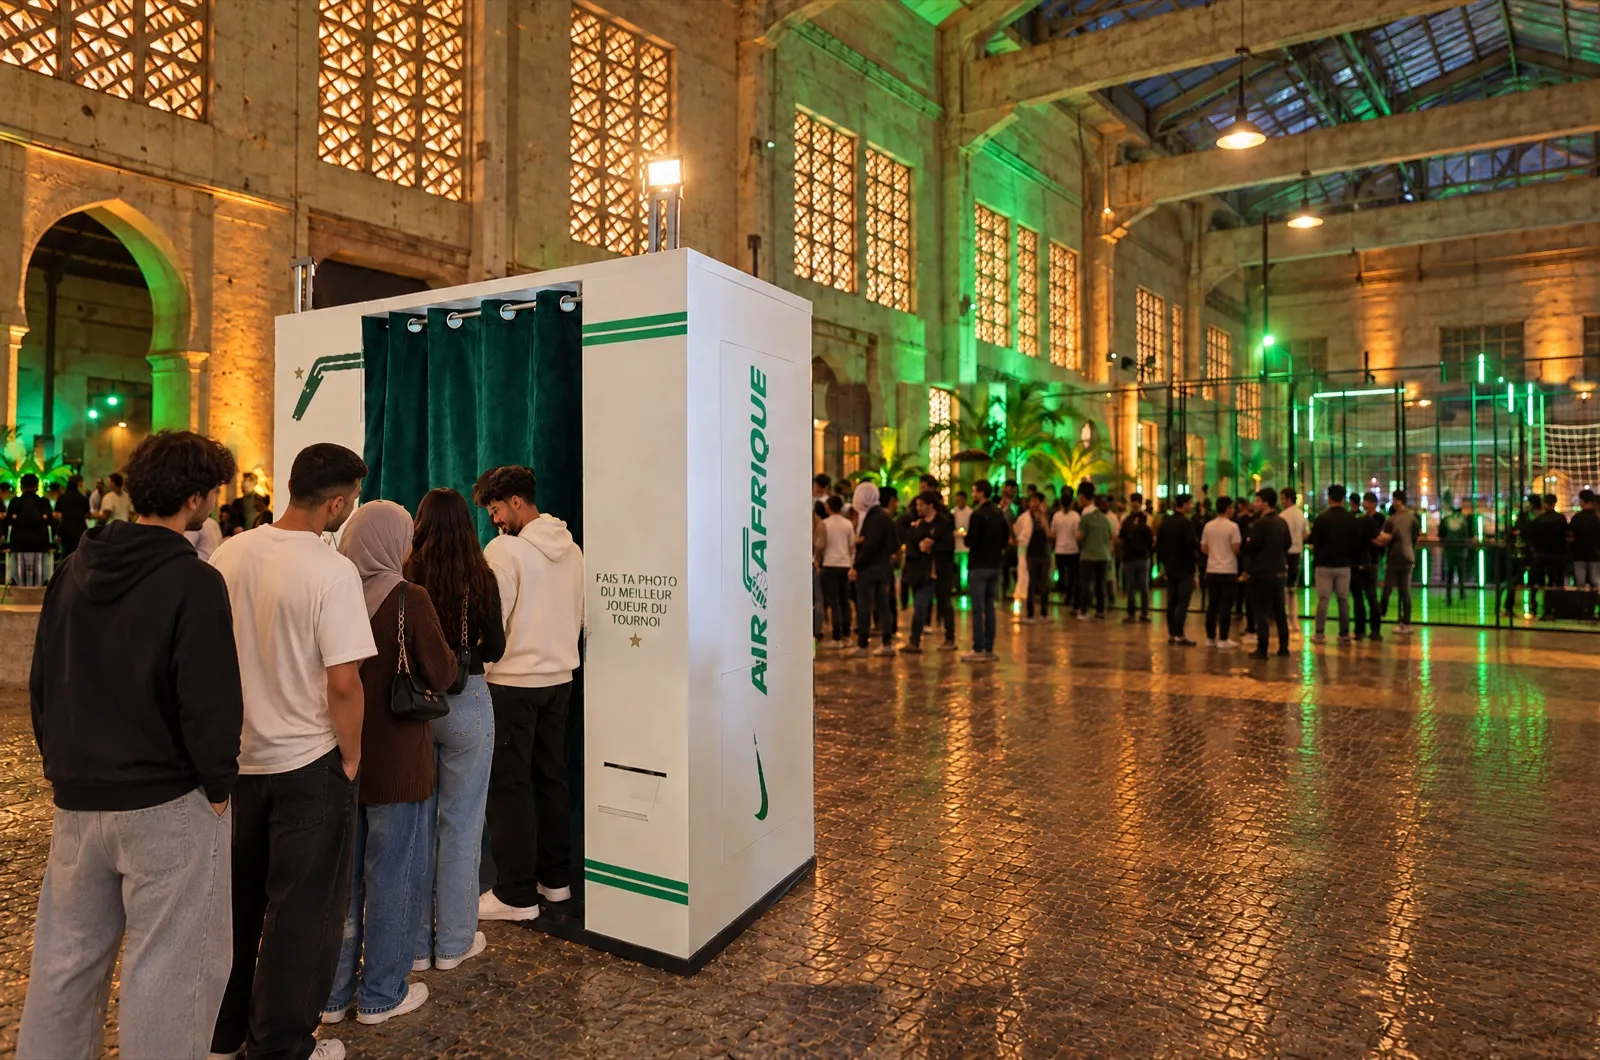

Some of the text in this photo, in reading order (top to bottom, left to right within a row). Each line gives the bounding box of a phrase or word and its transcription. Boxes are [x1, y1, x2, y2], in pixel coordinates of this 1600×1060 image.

[750, 365, 769, 696] AIR AFRIQUE
[596, 573, 678, 587] FAIS TA PHOTO
[600, 586, 672, 600] DU MEILLEUR
[605, 600, 667, 615] JOUEUR DU
[612, 614, 661, 627] TOURNOI
